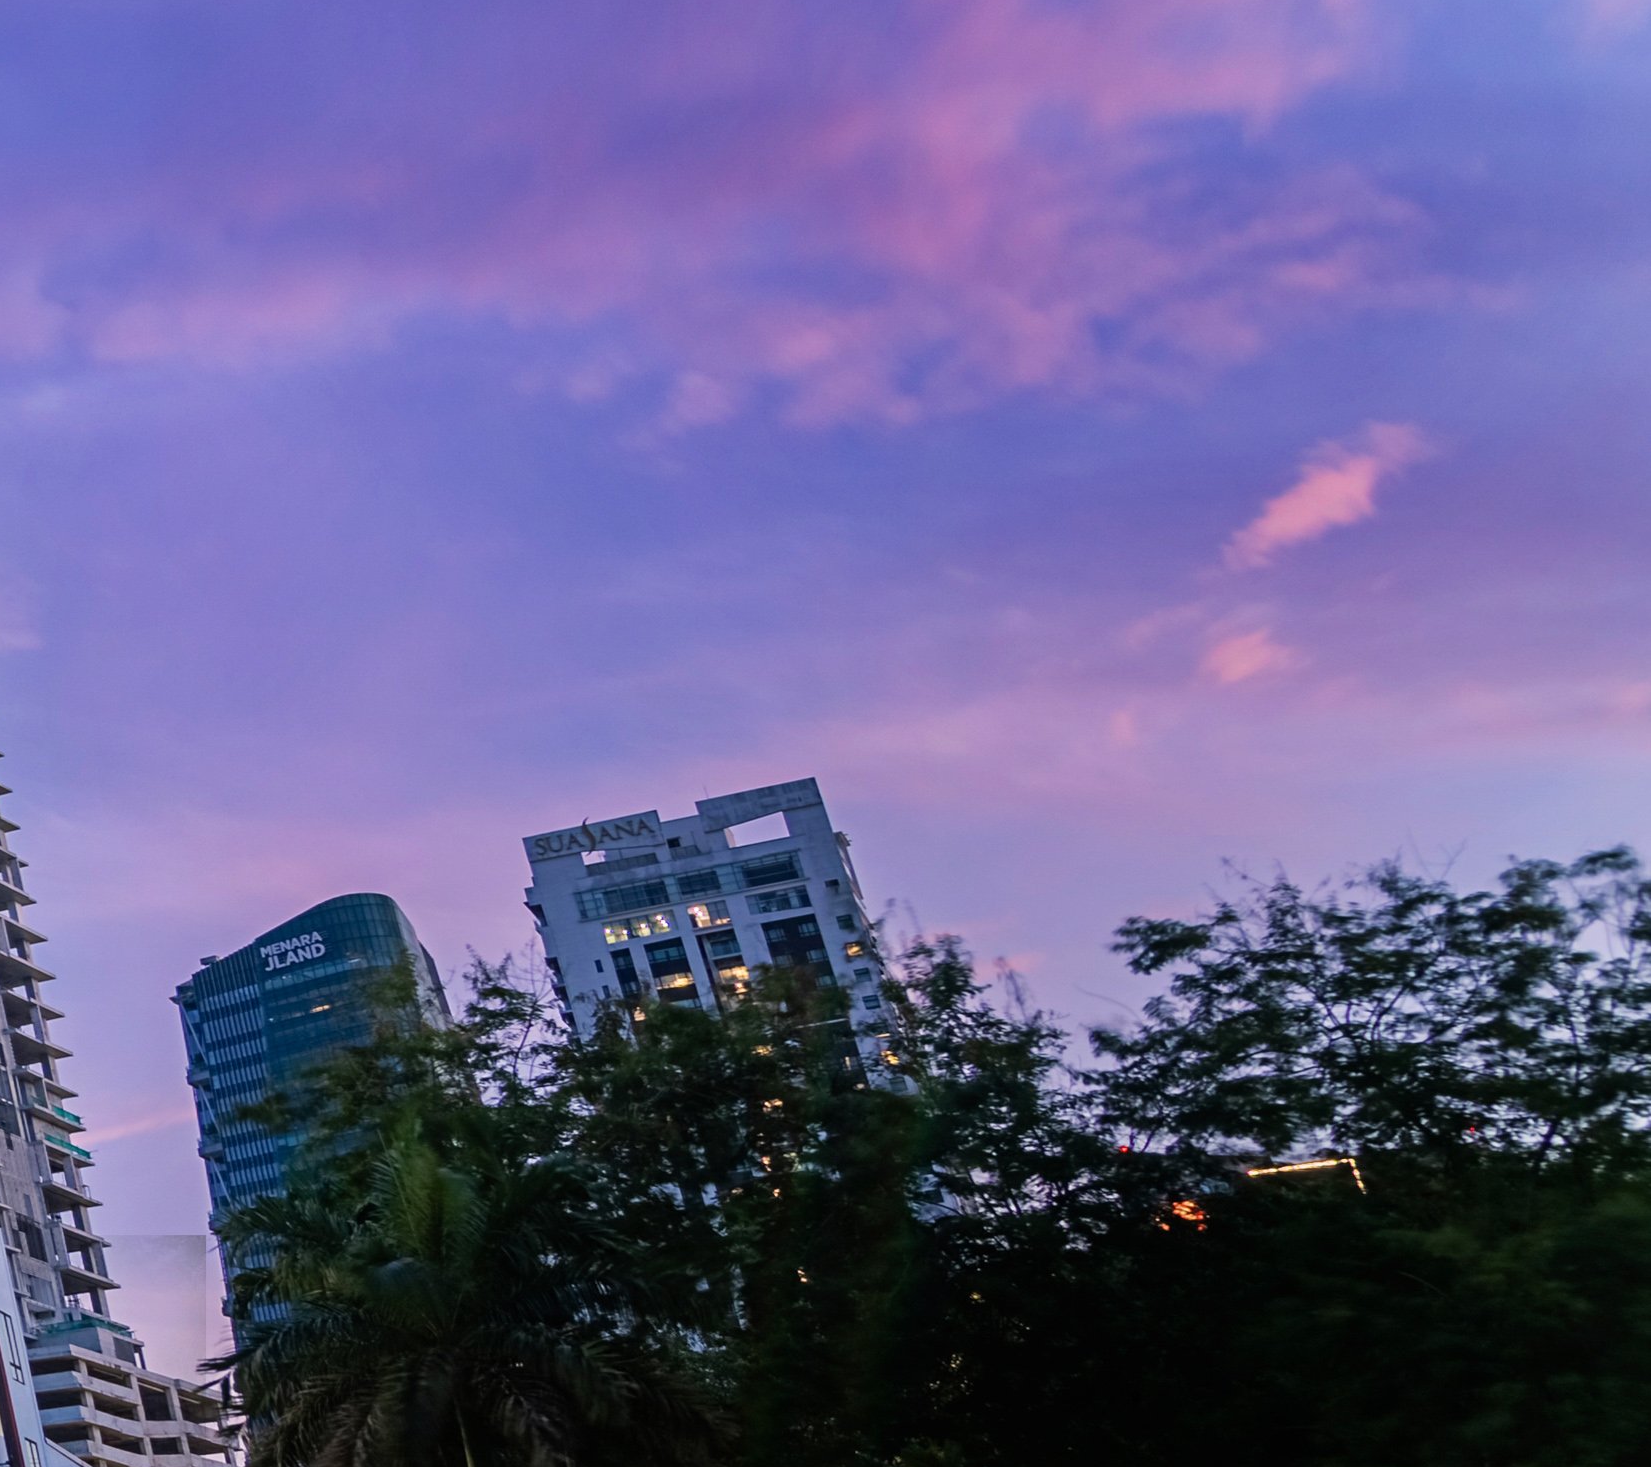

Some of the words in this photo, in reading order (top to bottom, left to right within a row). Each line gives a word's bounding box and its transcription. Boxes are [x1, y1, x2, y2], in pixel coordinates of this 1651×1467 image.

[533, 817, 656, 856] SUASANA
[259, 931, 323, 958] MENARA
[265, 943, 326, 972] JLAND
